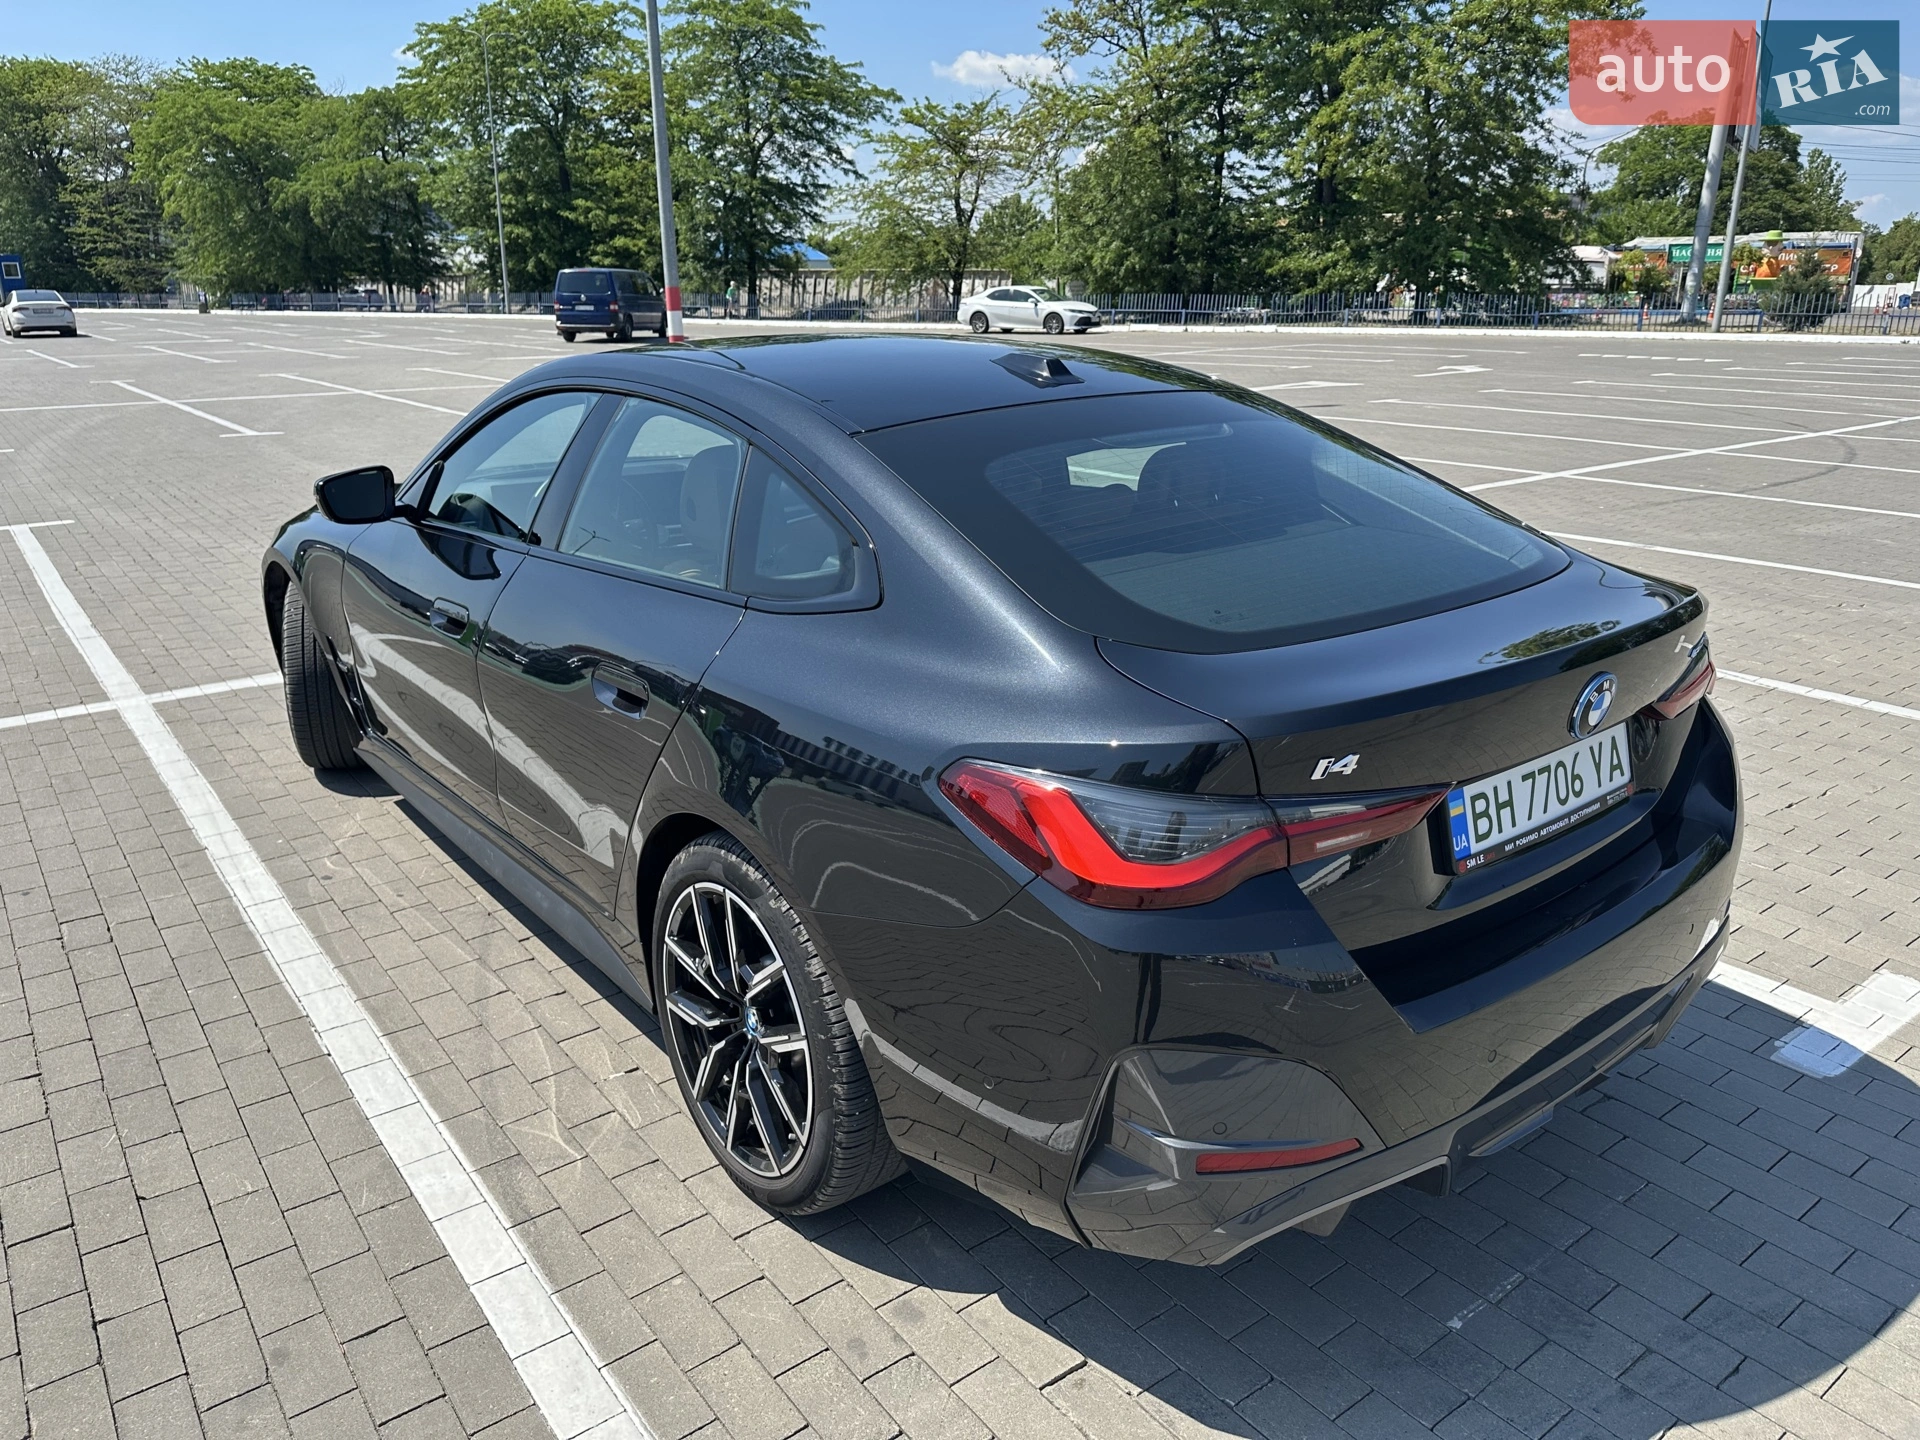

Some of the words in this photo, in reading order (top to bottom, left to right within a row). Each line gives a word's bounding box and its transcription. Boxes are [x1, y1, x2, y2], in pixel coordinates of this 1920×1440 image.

[1672, 248, 1723, 257] НАСНЯ
[1311, 753, 1360, 780] i4
[1469, 780, 1517, 843] BH
[1521, 752, 1584, 821] 7706
[1589, 735, 1626, 788] YA
[1453, 833, 1468, 851] UA
[1504, 843, 1515, 852] МИ
[1515, 832, 1539, 847] РОБИМО
[1466, 854, 1485, 869] SMLE
